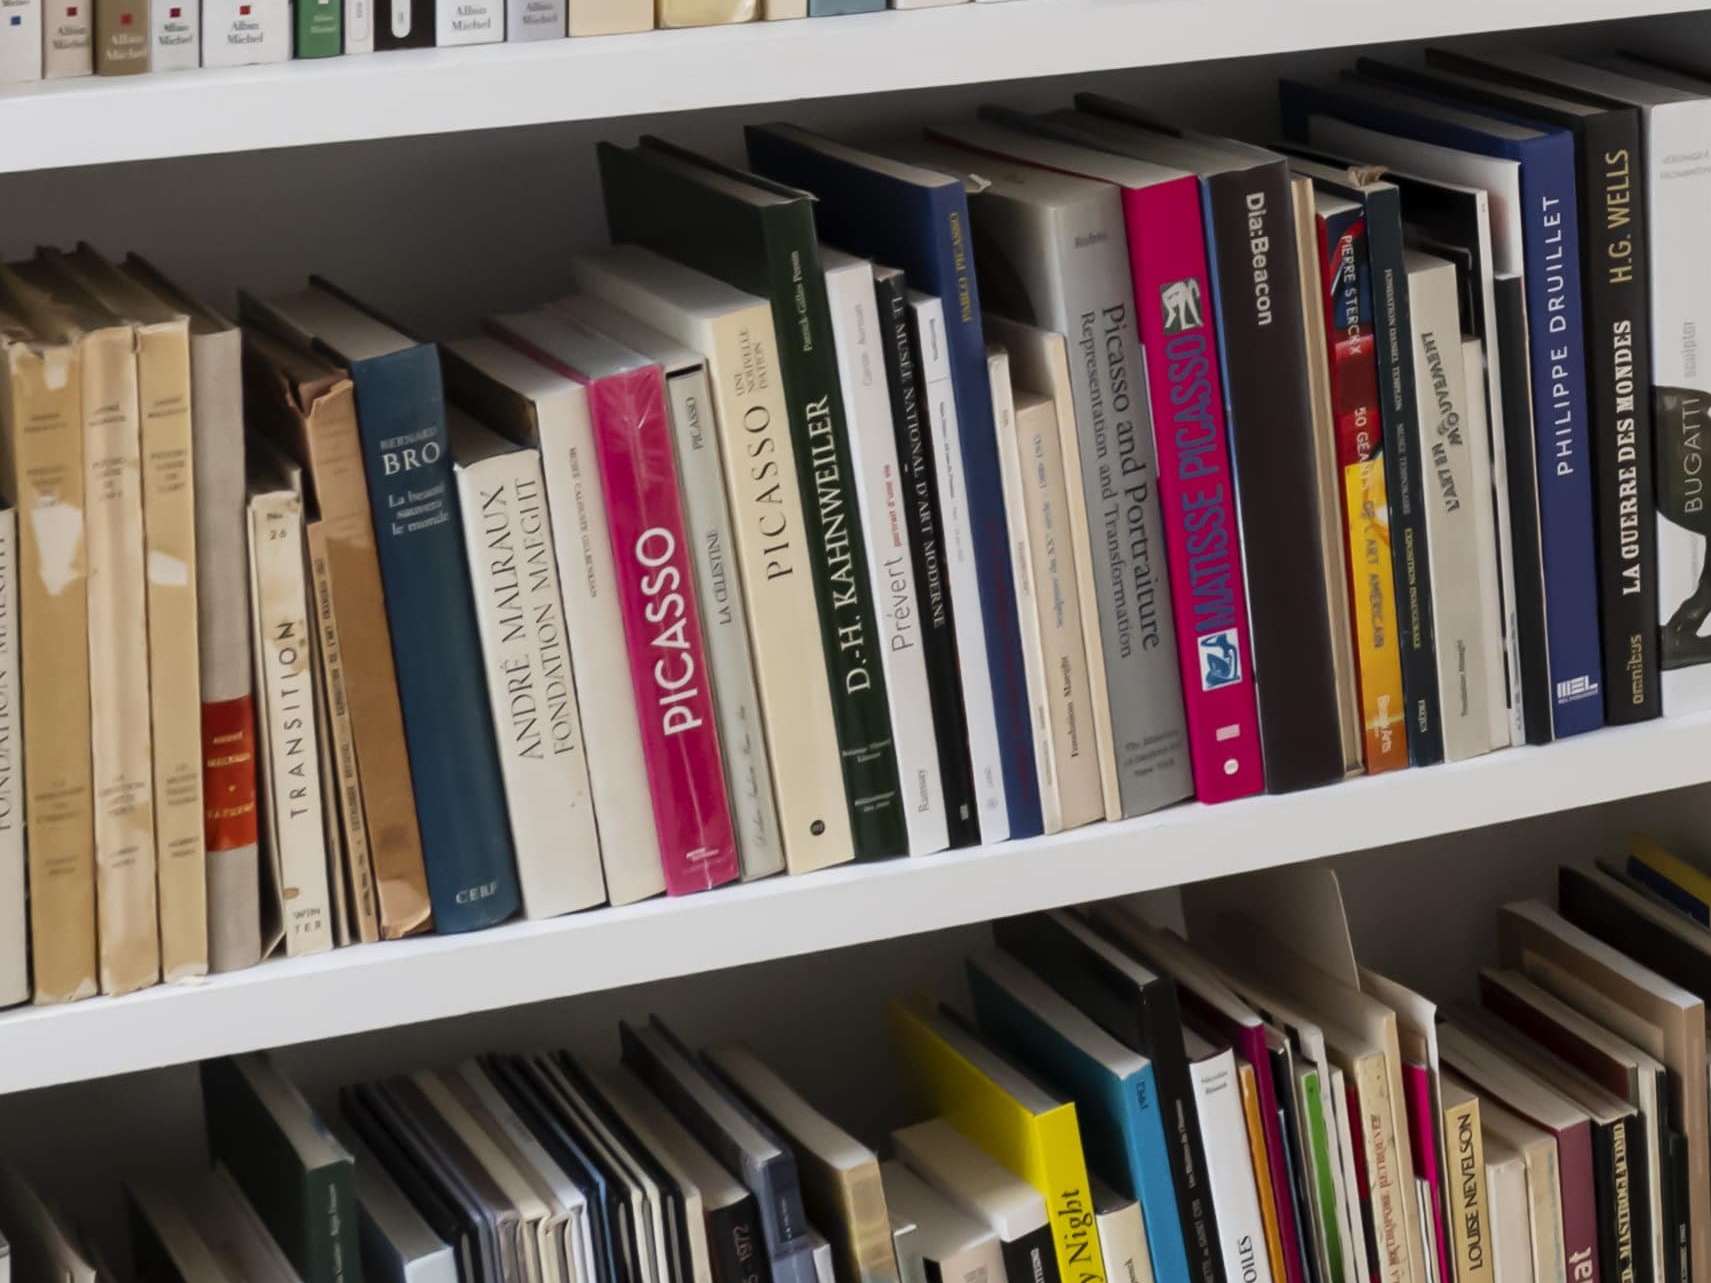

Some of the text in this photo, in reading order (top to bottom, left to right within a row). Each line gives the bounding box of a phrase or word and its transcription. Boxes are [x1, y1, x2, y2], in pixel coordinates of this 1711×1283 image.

[1244, 191, 1276, 327] Dia:Beacon
[1607, 147, 1634, 286] H.G. WELLS
[684, 395, 705, 451] PICASSO
[1542, 193, 1575, 478] PHILIPPE DRUILLET
[383, 441, 441, 476] BRO
[743, 403, 794, 583] PICASSO
[806, 393, 870, 697] D.-H. KAHNWEILER
[1102, 302, 1162, 651] Picasso and Portraiture
[1166, 333, 1238, 634] MATISSE PICASSO
[1612, 318, 1641, 598] LA GUERRE DES MONDES
[1682, 396, 1704, 514] BUGATTI
[480, 484, 545, 760] ANDRÉ MALRAUX
[516, 476, 574, 755] FONDATION MAEGHT
[636, 524, 704, 737] PICASSO
[881, 555, 916, 652] Prévert
[277, 621, 310, 819] TRANSITION
[1063, 1188, 1090, 1263] Night
[1454, 1113, 1483, 1272] LOUISE NEVELSON
